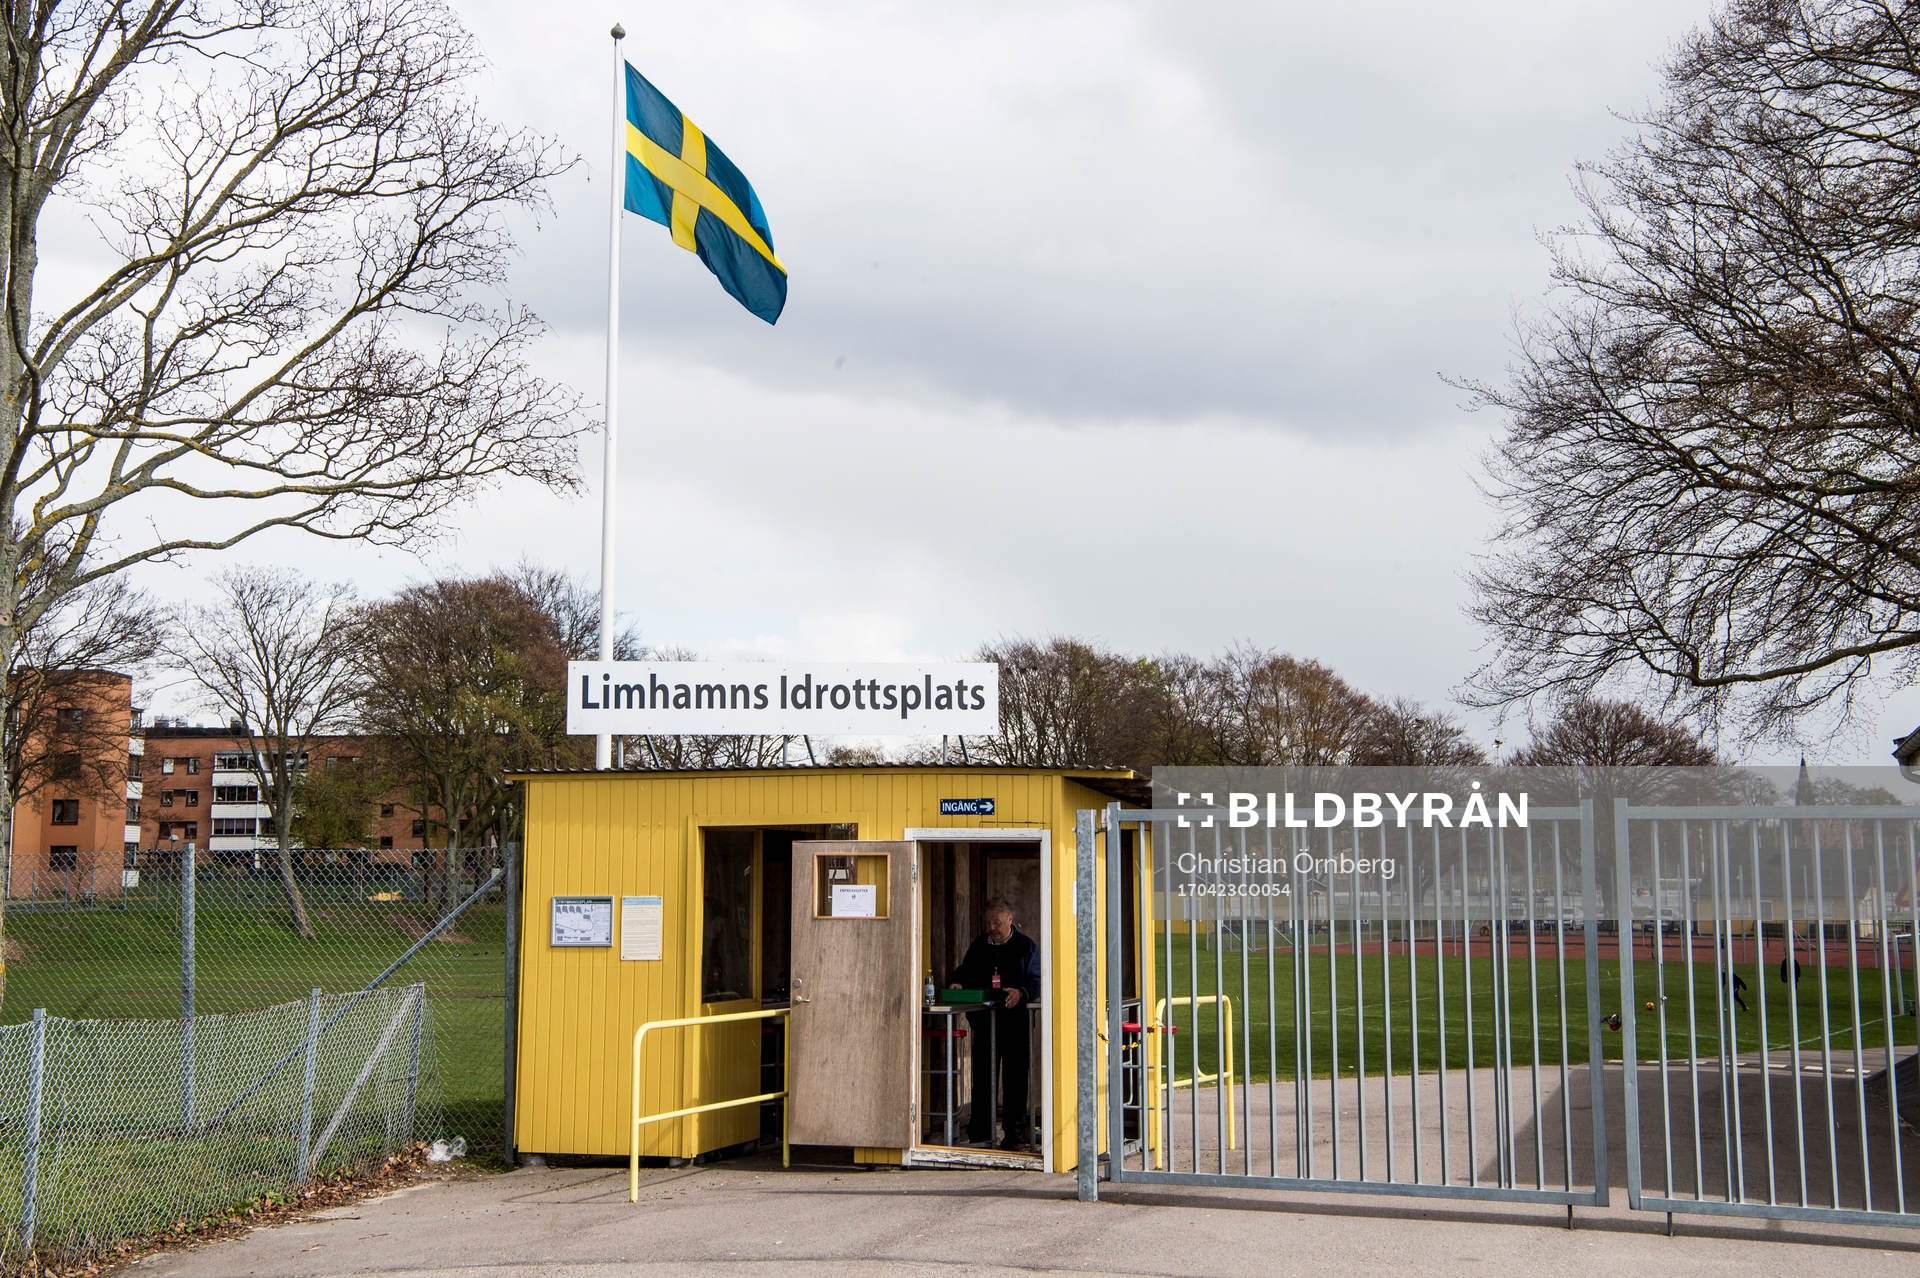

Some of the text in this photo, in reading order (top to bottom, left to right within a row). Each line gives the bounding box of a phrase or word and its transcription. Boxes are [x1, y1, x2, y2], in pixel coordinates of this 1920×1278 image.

[581, 673, 986, 719] Limhamns Idrottsplats
[942, 800, 977, 812] INGÅNG
